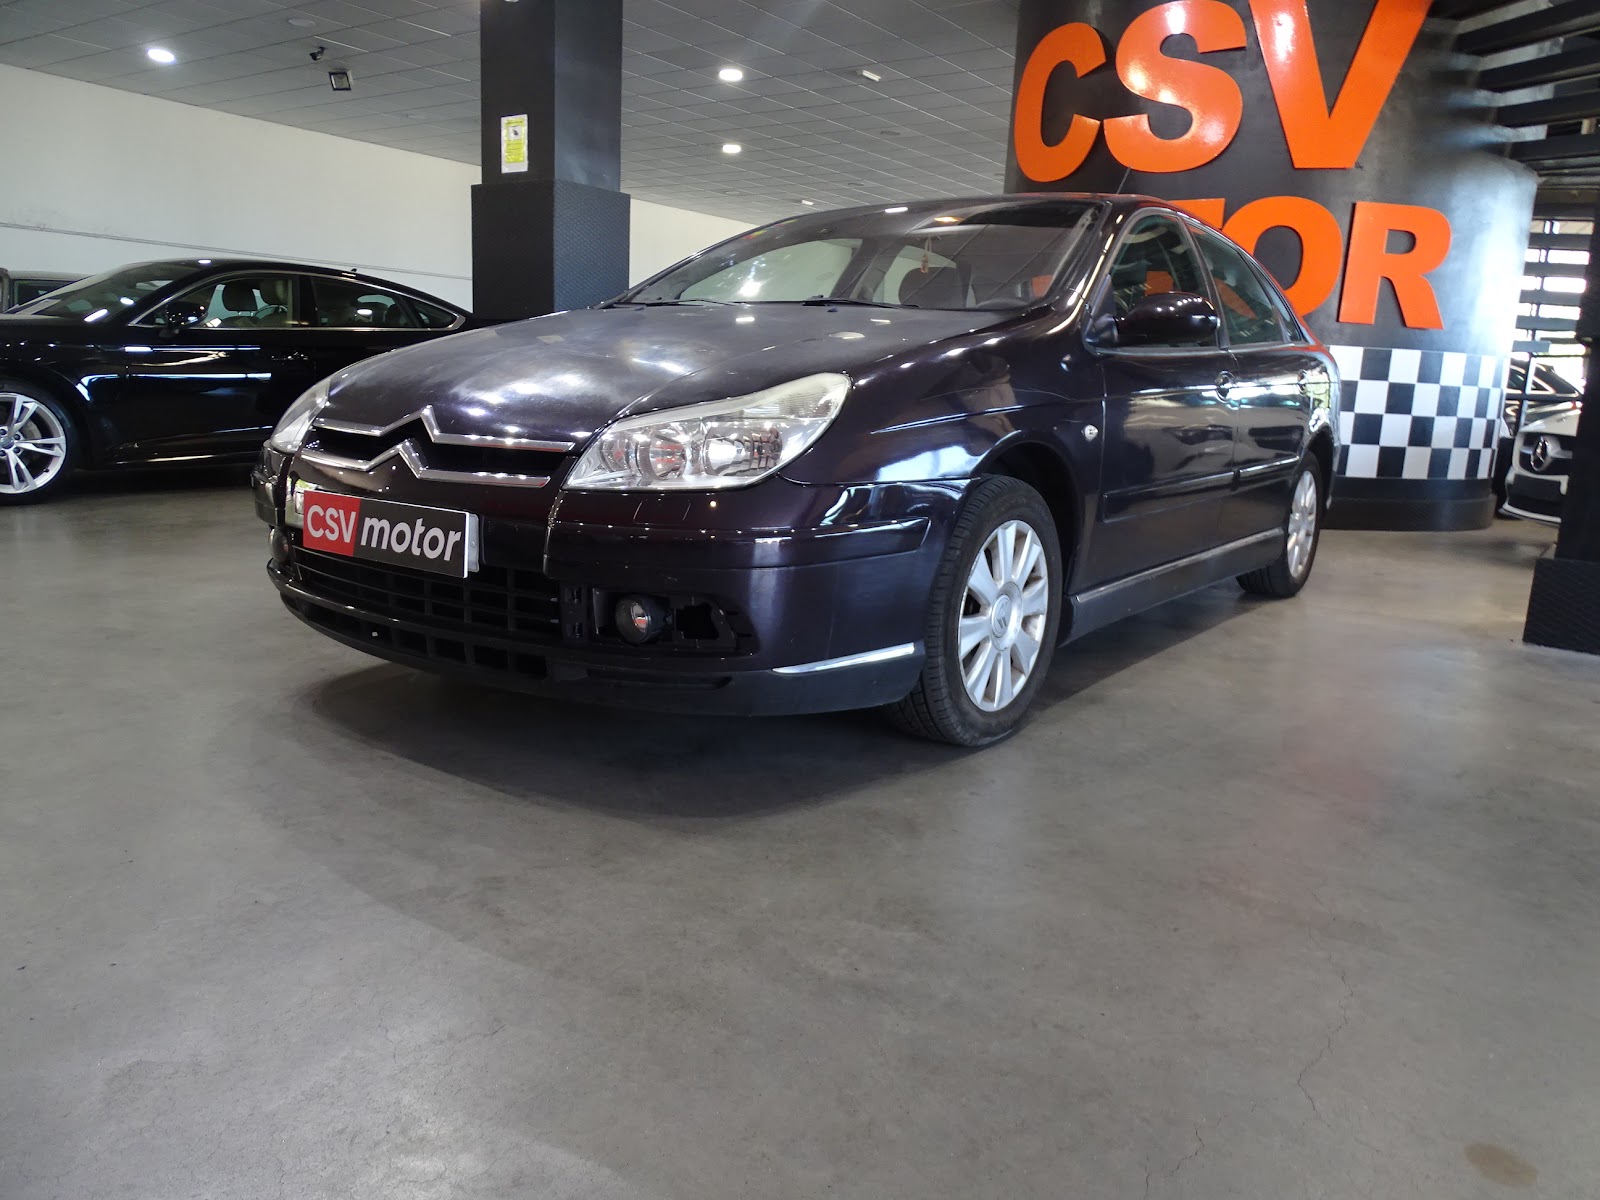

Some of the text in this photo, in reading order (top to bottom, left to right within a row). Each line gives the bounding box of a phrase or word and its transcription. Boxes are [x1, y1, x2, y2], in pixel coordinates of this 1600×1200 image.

[1014, 0, 1434, 182] CSV
[306, 504, 462, 561] CSV motor
